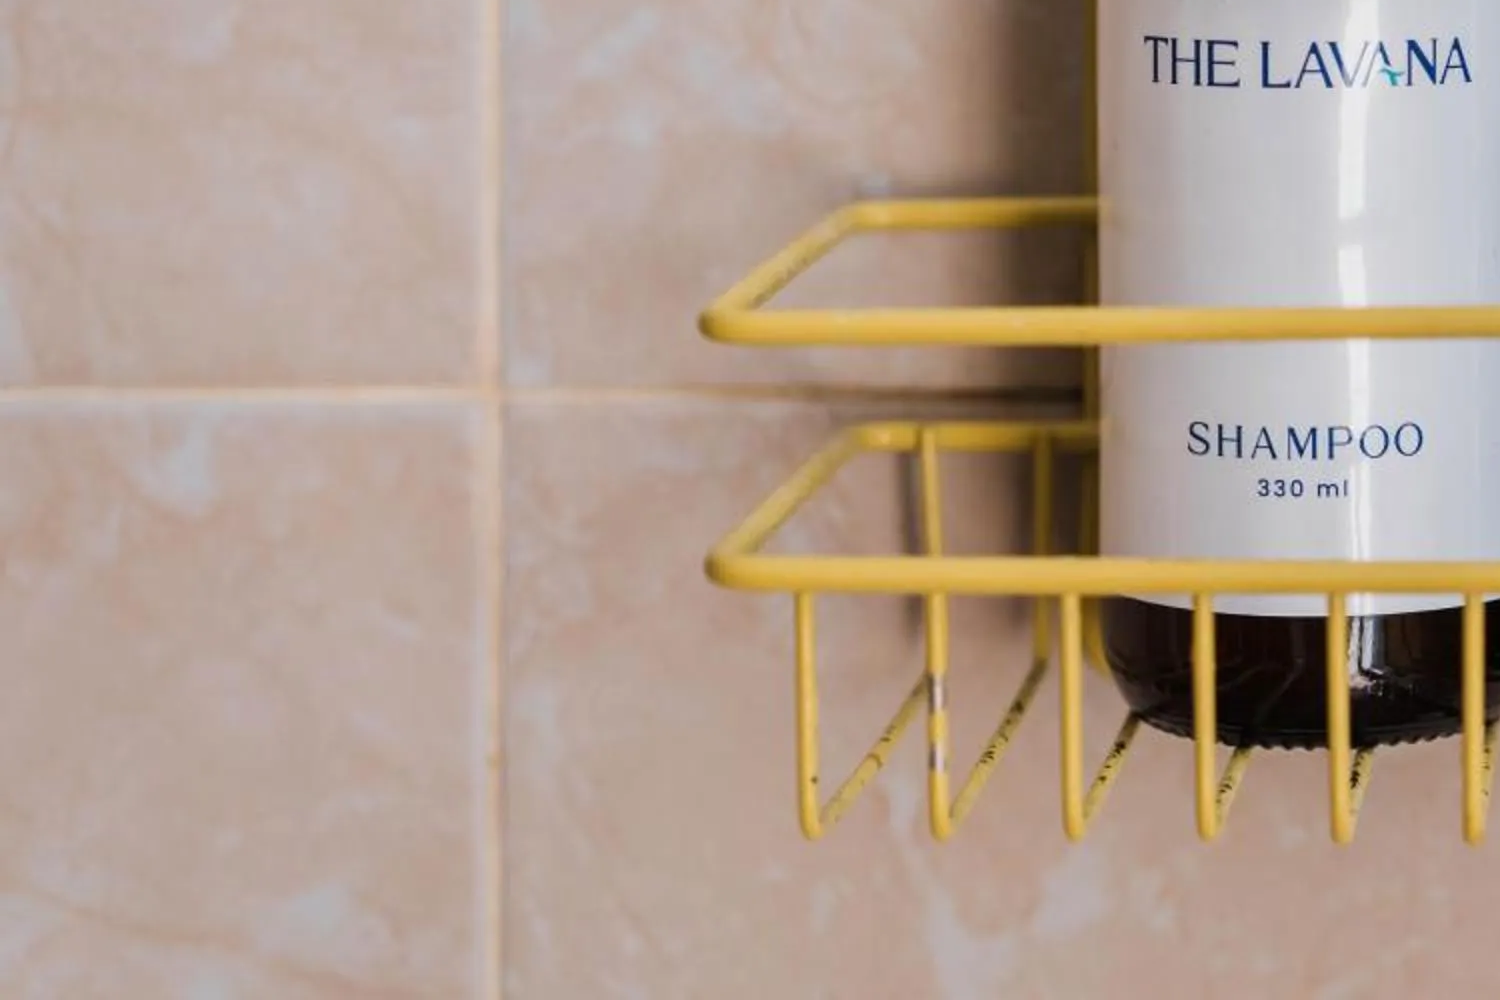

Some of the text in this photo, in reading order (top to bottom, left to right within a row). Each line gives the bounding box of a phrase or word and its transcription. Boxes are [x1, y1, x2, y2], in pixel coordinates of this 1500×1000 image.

[1143, 35, 1473, 89] THE LAVANA
[1186, 421, 1424, 460] SHAMPOO
[1256, 479, 1349, 498] 330 ml
